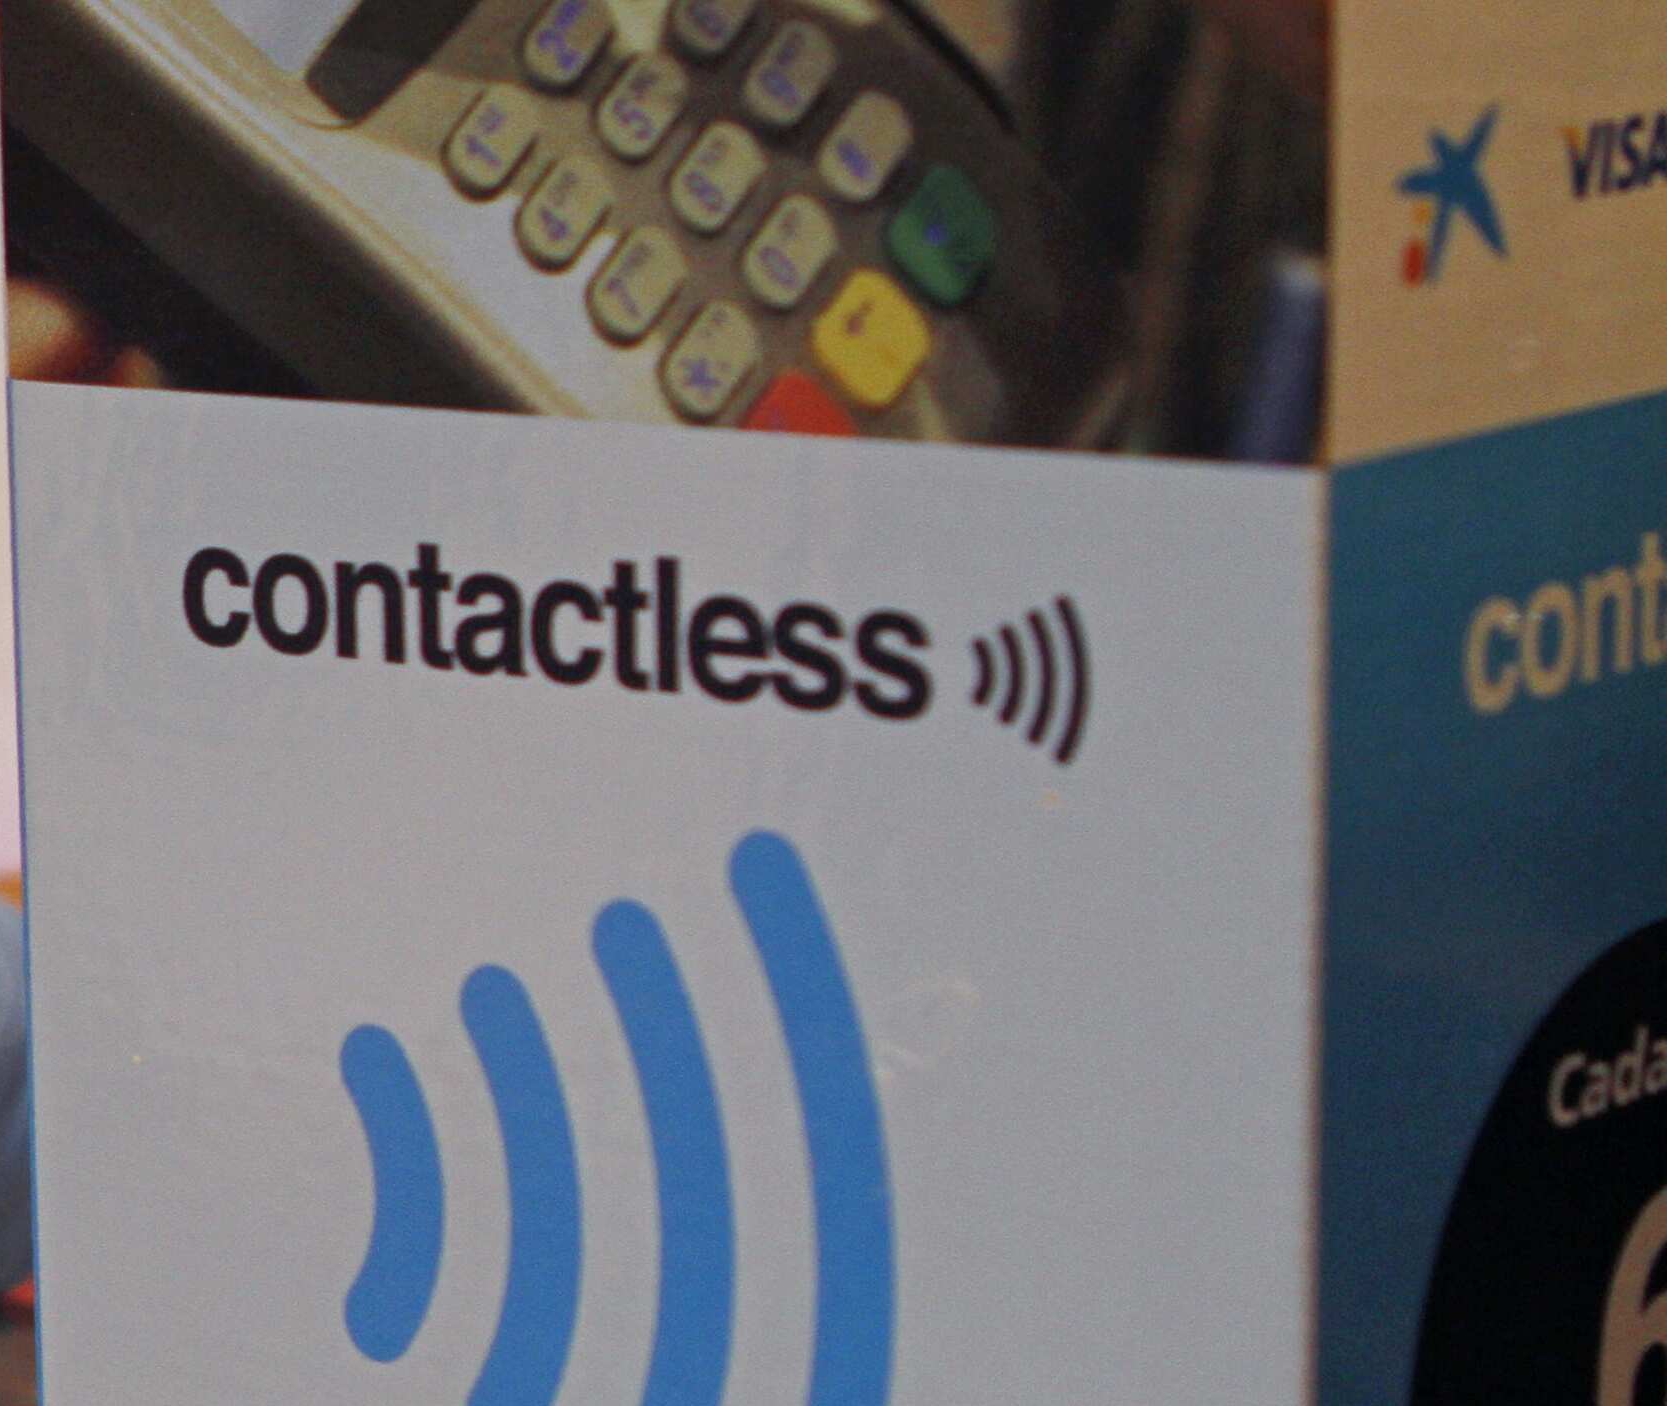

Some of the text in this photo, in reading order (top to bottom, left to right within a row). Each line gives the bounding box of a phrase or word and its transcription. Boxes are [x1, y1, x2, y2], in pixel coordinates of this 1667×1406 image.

[1561, 109, 1667, 199] VISA
[181, 542, 933, 722] contactless
[1464, 531, 1667, 716] cont
[1547, 1022, 1667, 1129] Cada
